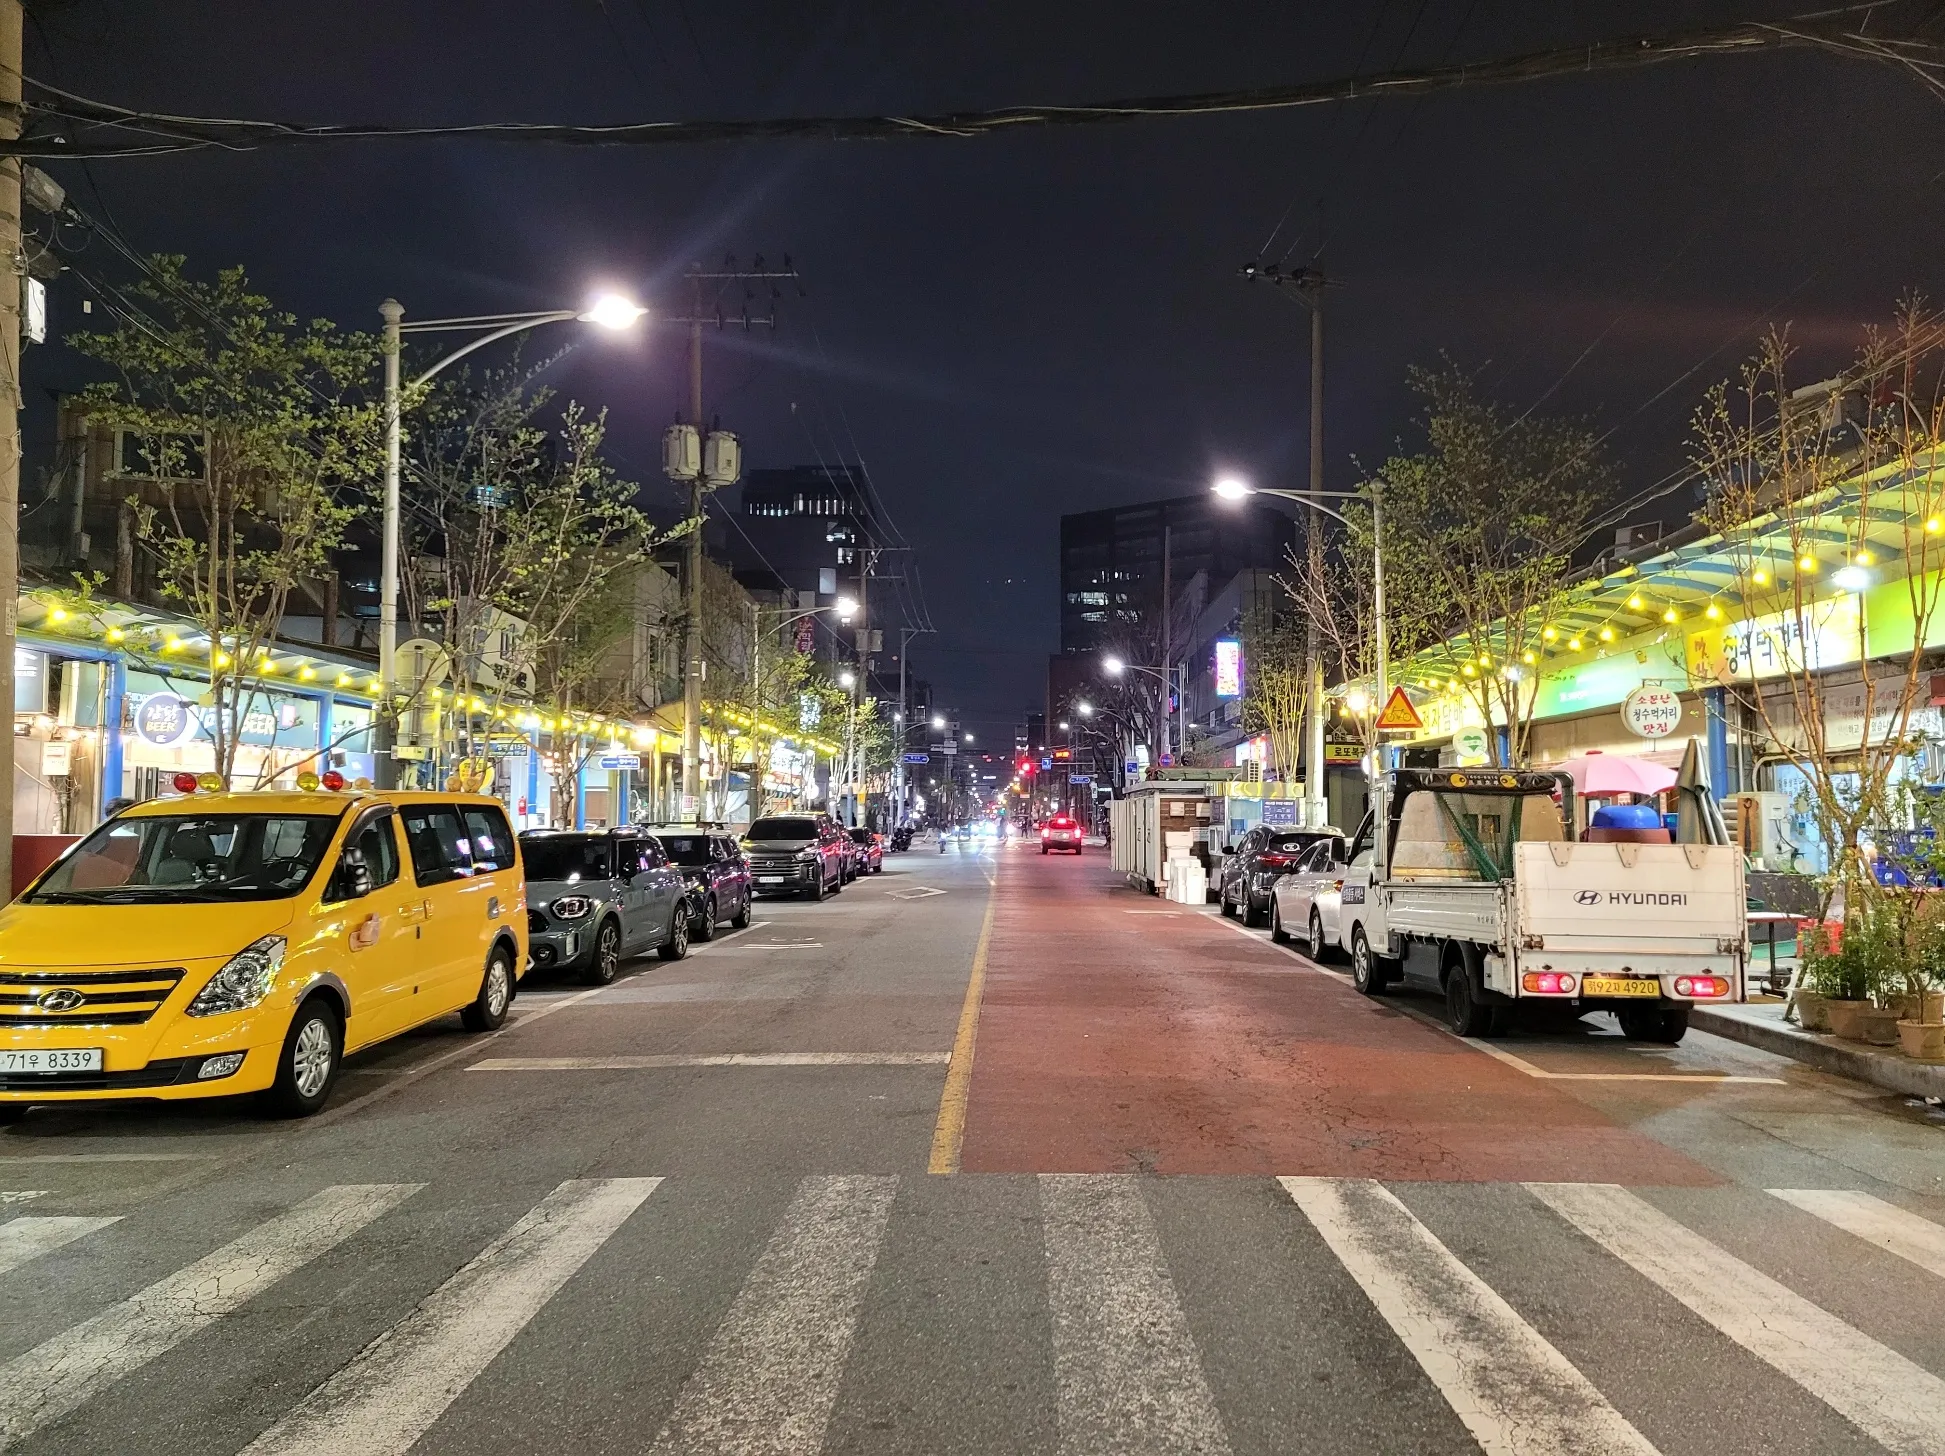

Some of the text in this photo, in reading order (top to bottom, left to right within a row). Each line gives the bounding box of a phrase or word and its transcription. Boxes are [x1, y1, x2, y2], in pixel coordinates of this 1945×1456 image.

[1637, 694, 1671, 705] 소문난
[1633, 707, 1677, 722] 청수먹거리
[146, 720, 176, 732] BEER
[1643, 723, 1668, 735] 맛집
[1609, 892, 1687, 906] HYUNDAI
[1624, 981, 1655, 994] 4920
[7, 1052, 92, 1069] 71우 8339
